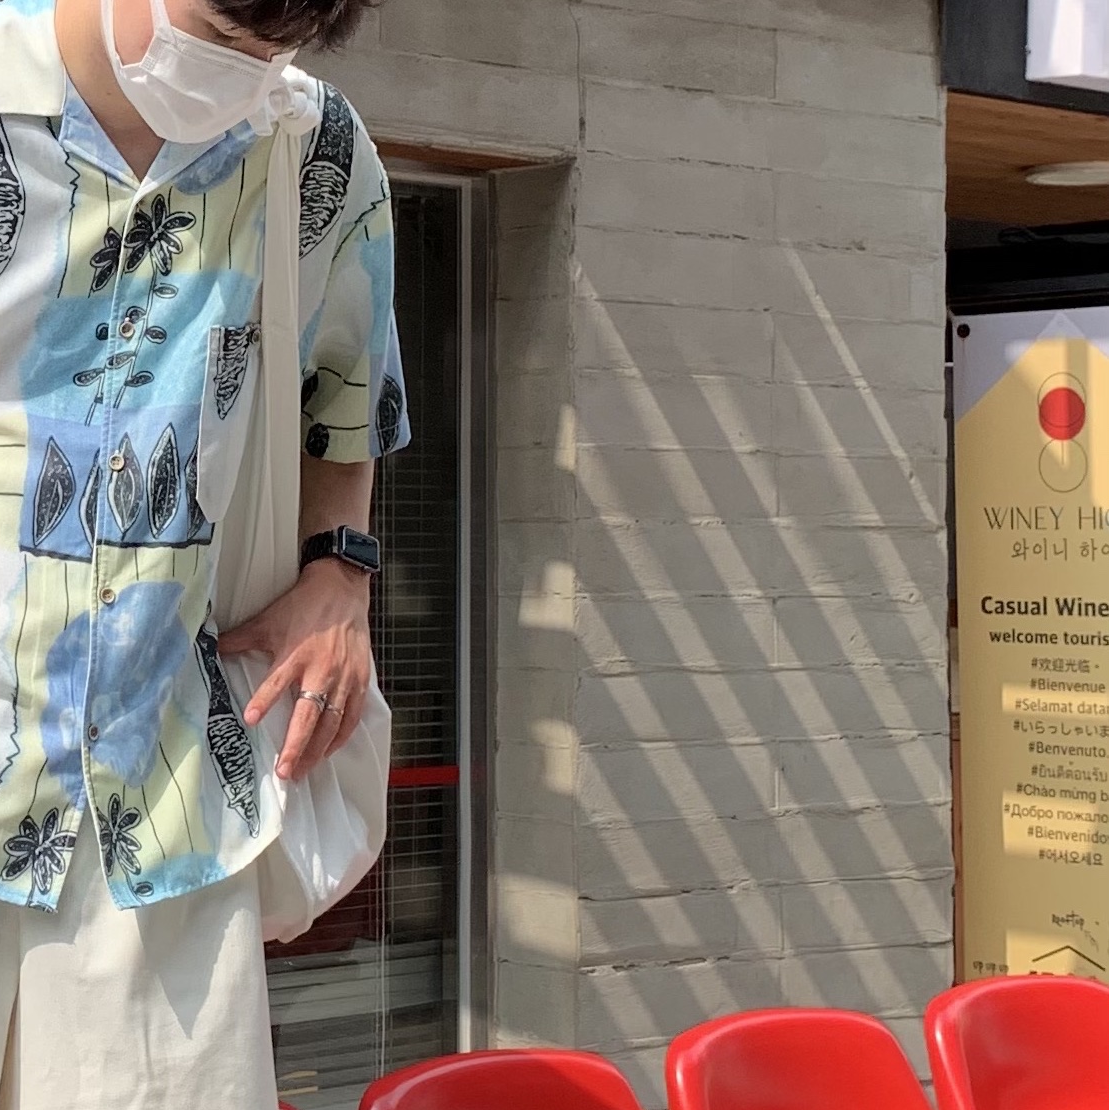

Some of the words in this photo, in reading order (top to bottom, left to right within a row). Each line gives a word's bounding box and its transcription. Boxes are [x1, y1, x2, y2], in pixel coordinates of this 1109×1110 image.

[983, 506, 1064, 530] WINEY
[1078, 506, 1109, 530] HI
[1011, 538, 1067, 561] 와이니
[980, 595, 1047, 615] Casual
[1055, 597, 1109, 617] Wine
[989, 628, 1058, 644] welcome
[1030, 678, 1106, 693] #Bienvenue
[1015, 698, 1073, 714] #Selamat
[1004, 803, 1054, 820] #Добро
[1027, 825, 1109, 844] #Bienvenido
